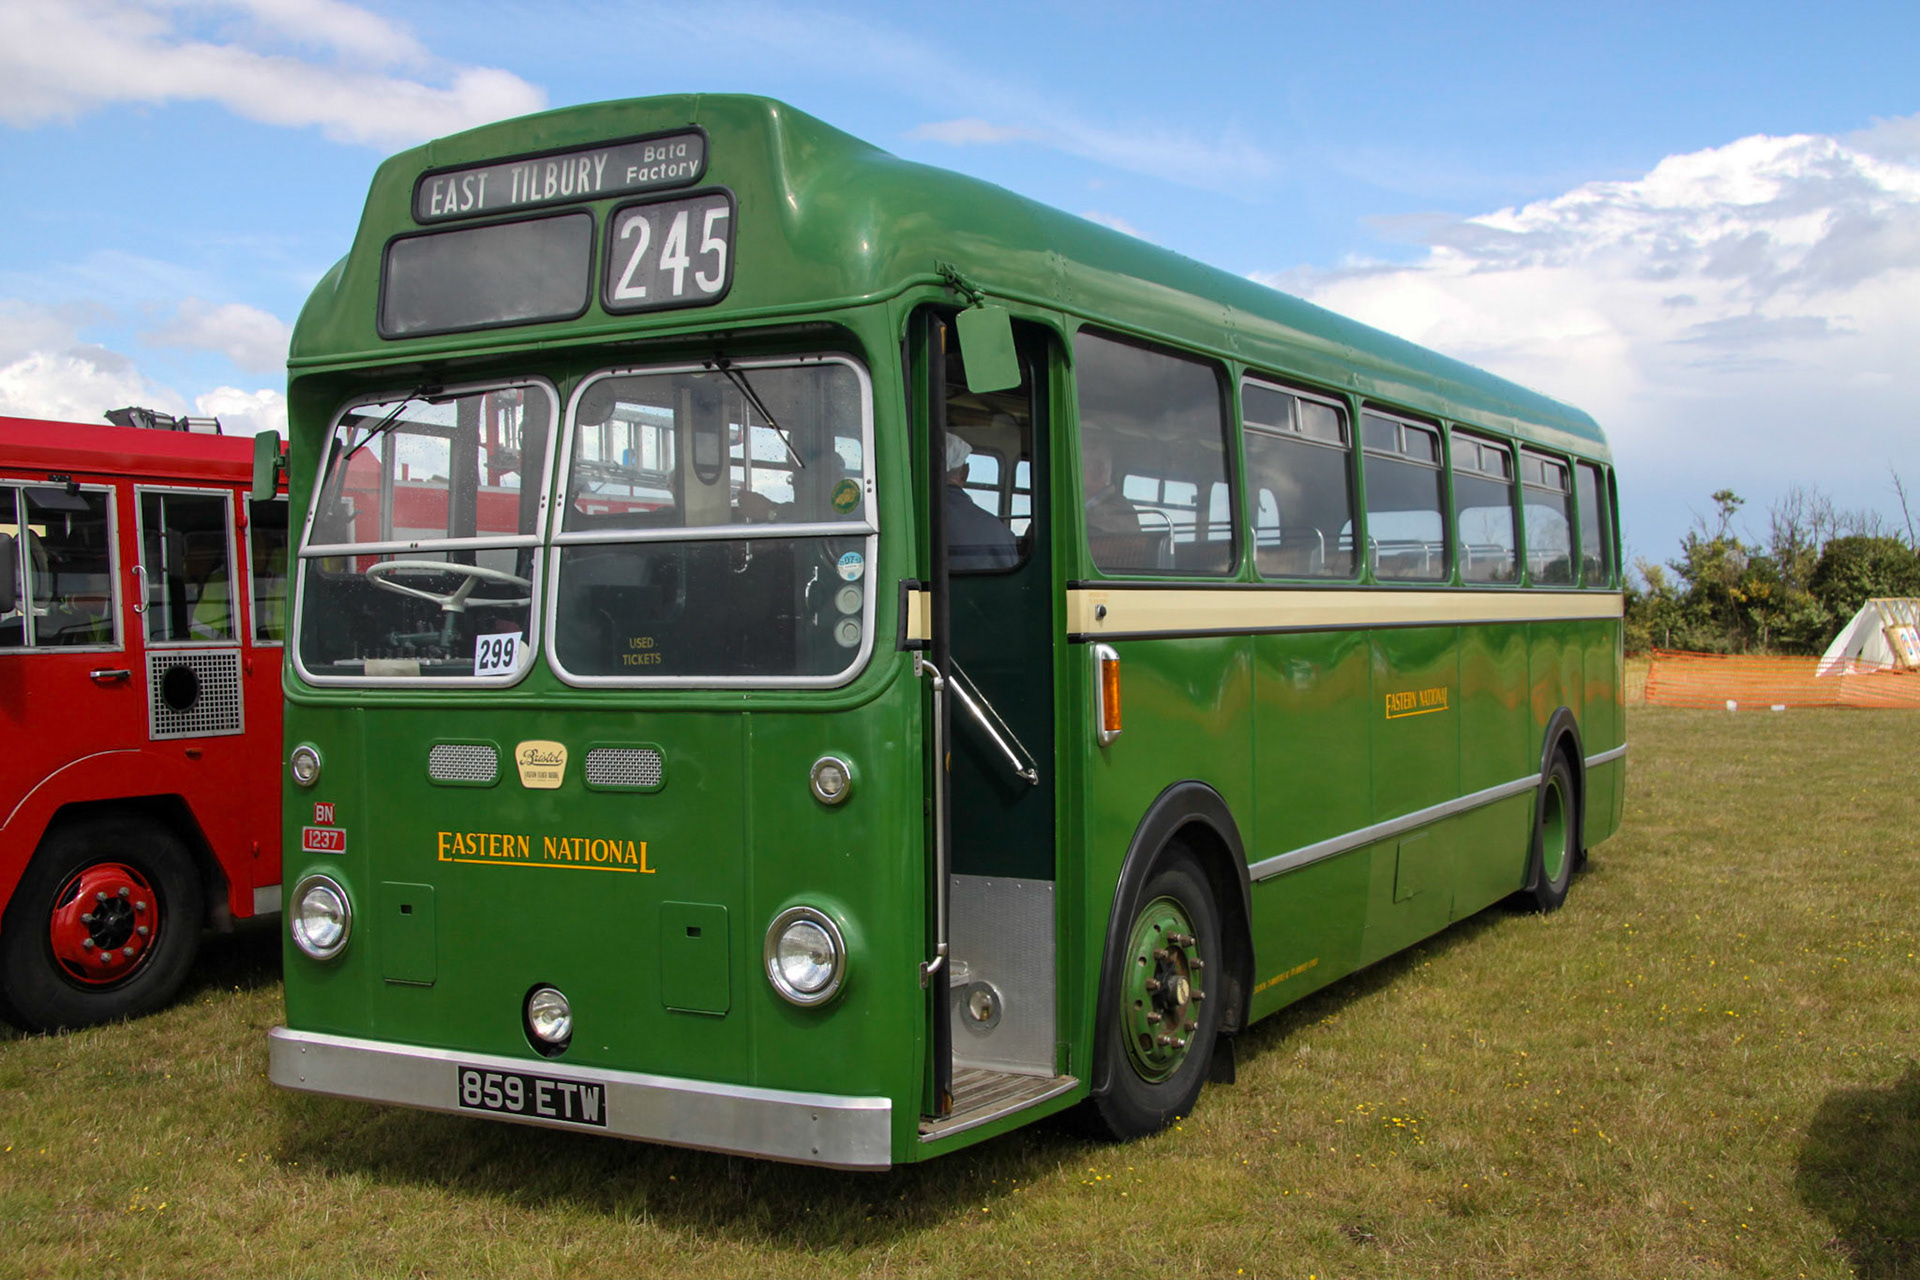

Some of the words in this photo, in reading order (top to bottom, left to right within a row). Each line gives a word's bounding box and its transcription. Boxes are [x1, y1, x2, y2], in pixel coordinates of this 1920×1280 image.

[643, 142, 687, 163] Bata
[430, 172, 488, 217] EAST
[510, 152, 609, 204] TILBURY
[625, 158, 700, 185] Factory
[614, 206, 731, 301] 245
[479, 637, 516, 670] 299
[629, 637, 655, 649] USED
[622, 652, 662, 666] TICKETS
[1386, 691, 1418, 719] EASTERN
[519, 747, 563, 767] Bristol
[316, 804, 333, 822] BN
[308, 830, 339, 849] 1237
[437, 831, 531, 862] EASTERN
[543, 836, 656, 874] NATIONAL
[462, 1070, 525, 1111] 859
[535, 1079, 600, 1122] ETW
